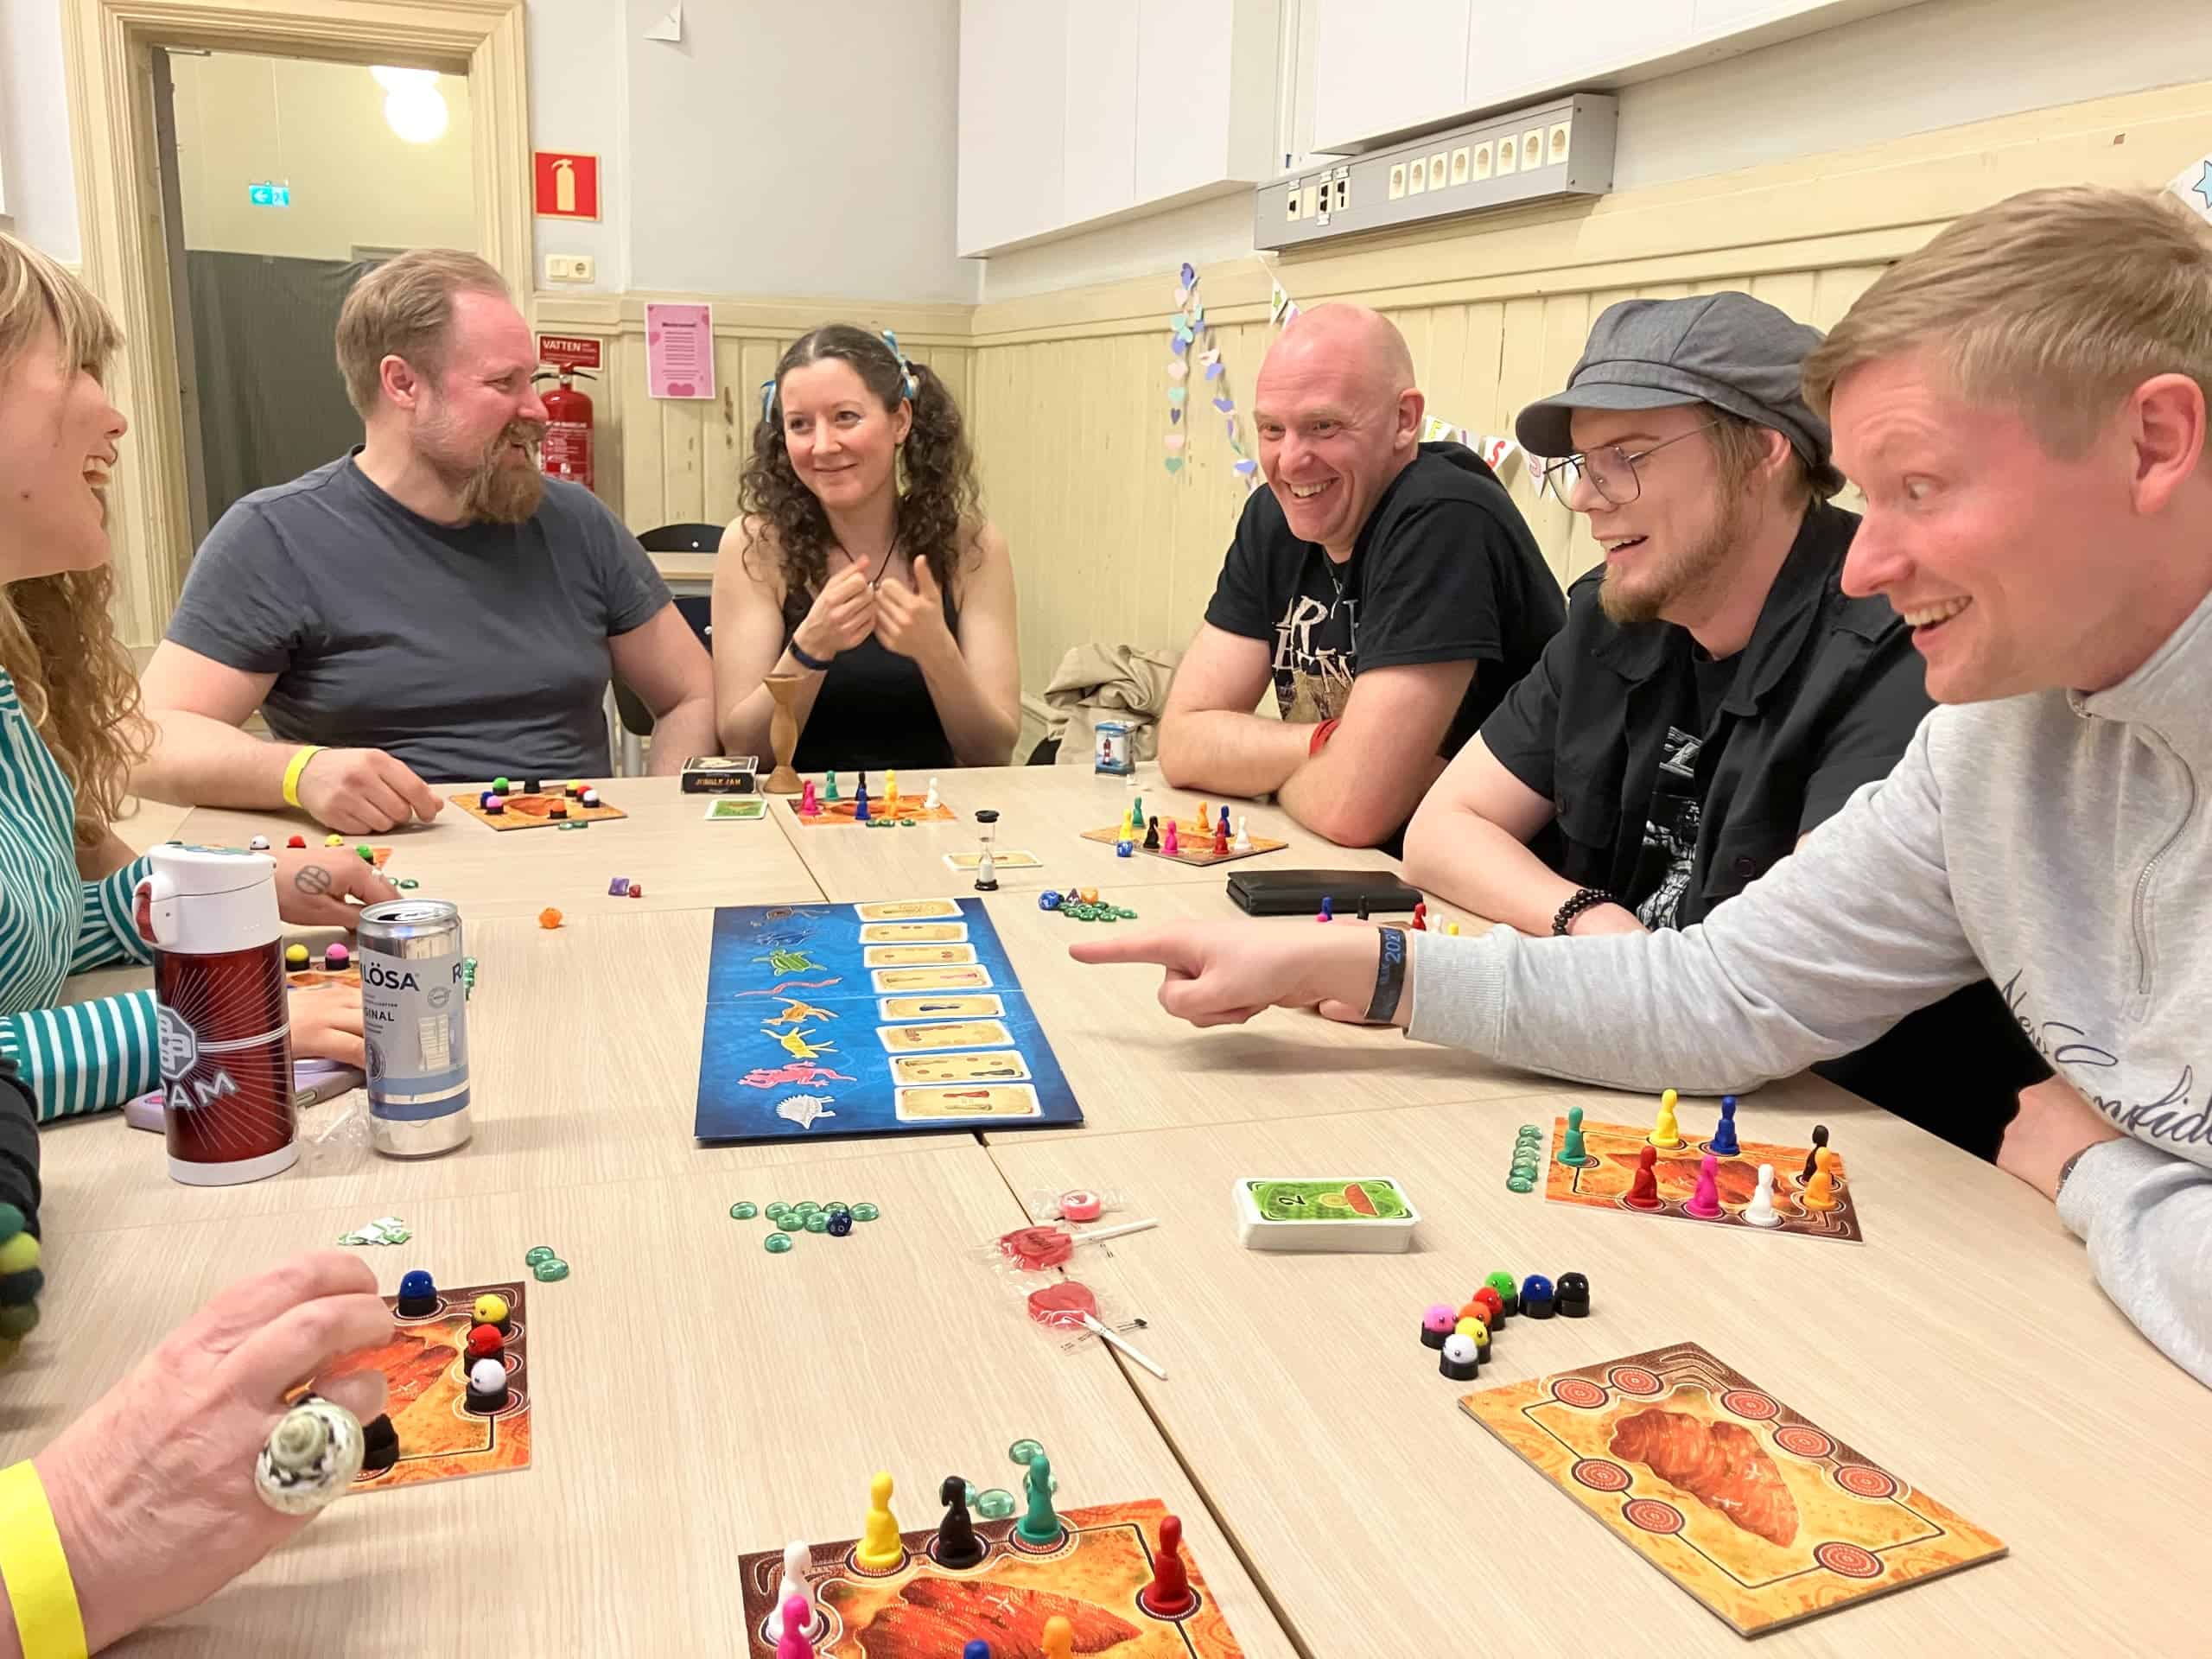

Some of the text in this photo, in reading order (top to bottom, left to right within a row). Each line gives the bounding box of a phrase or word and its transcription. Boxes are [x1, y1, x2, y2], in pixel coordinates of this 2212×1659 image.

[542, 339, 582, 352] VATTEN
[359, 961, 420, 991] LÖSA
[160, 1071, 236, 1109] AM
